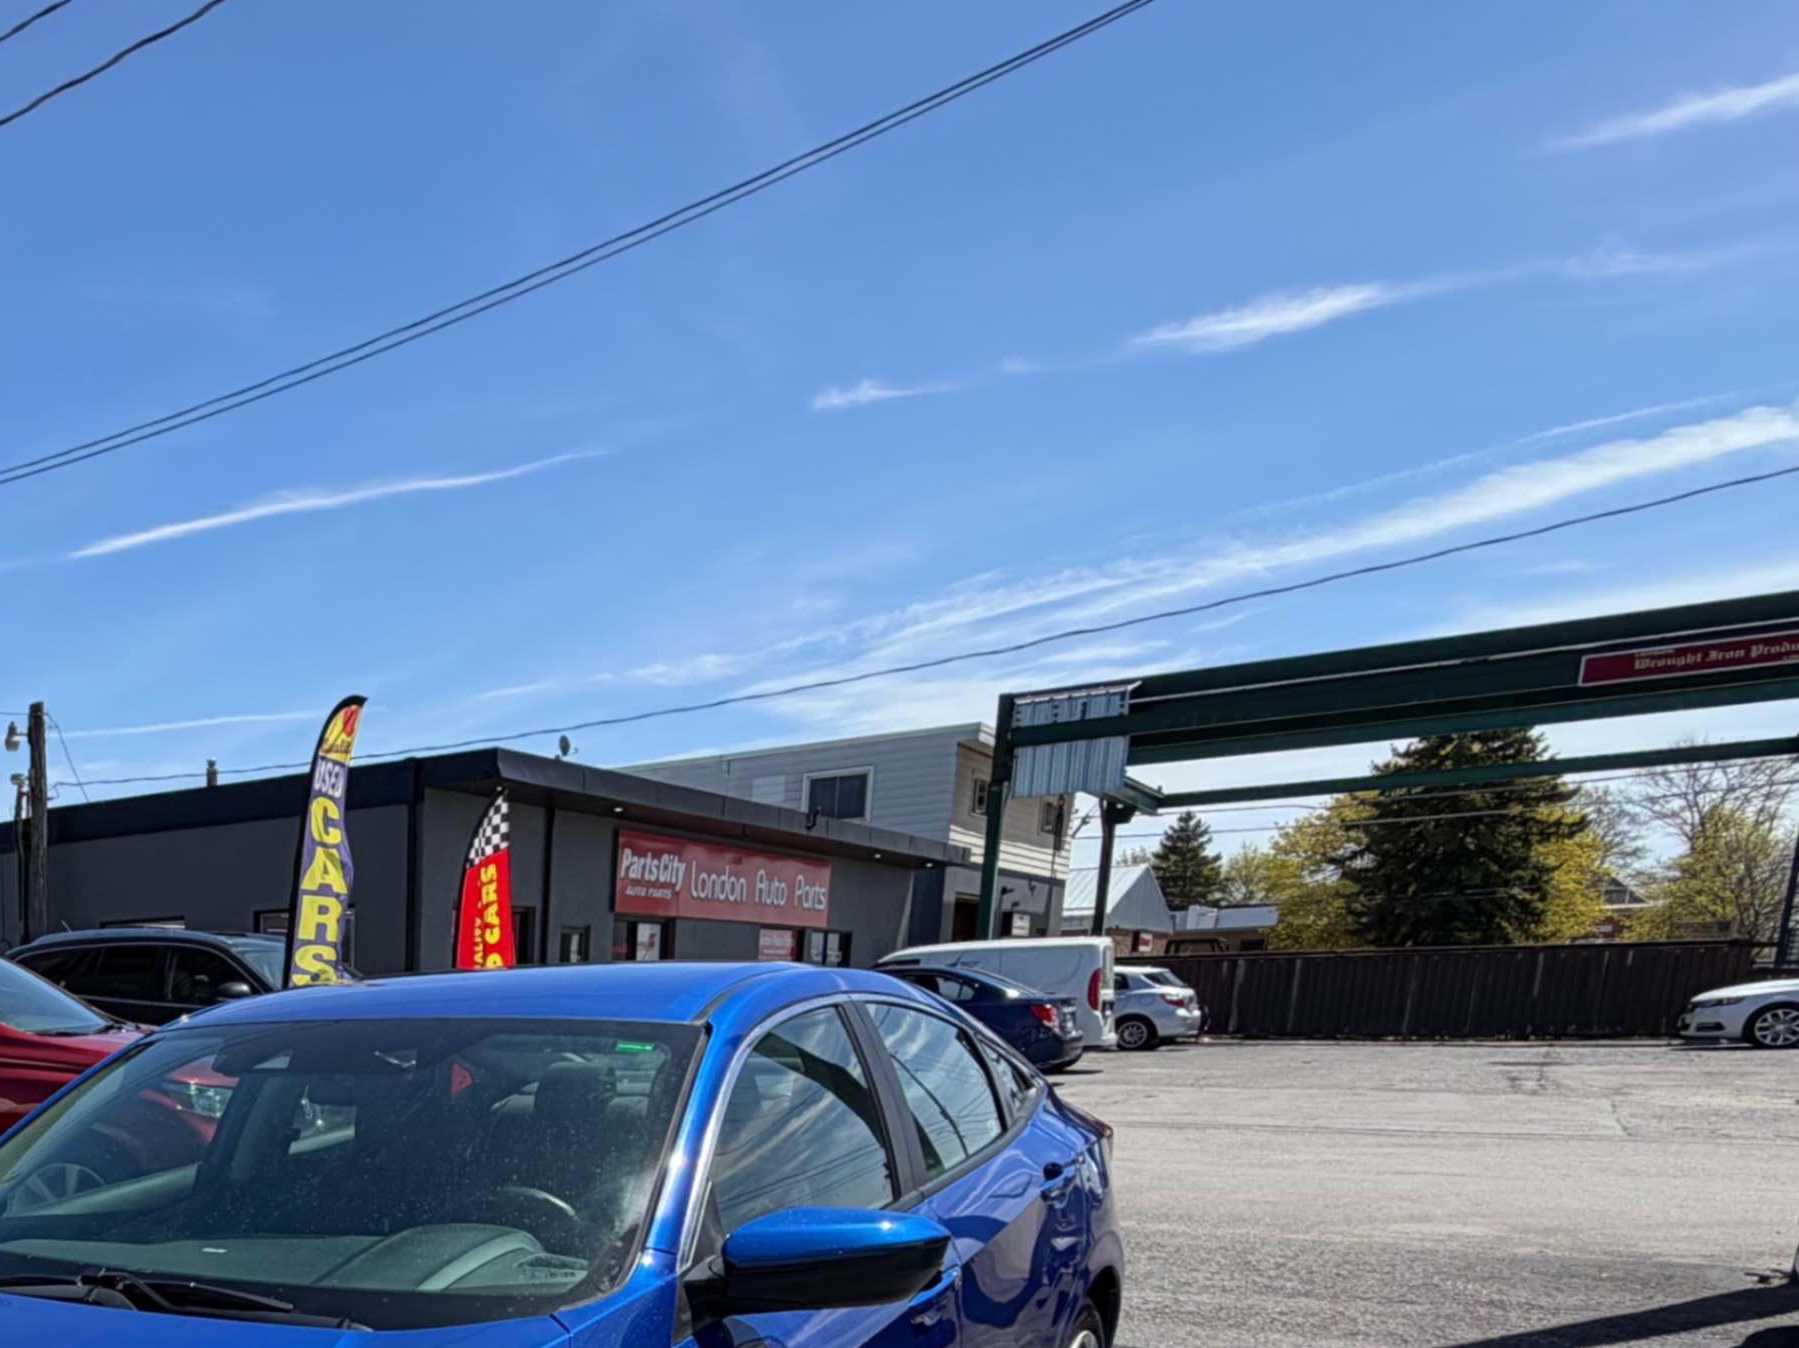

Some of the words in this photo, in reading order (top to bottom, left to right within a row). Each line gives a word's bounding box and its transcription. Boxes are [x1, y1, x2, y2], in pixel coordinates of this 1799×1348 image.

[1634, 653, 1702, 670] Wrought
[314, 761, 343, 798] USED
[292, 796, 349, 986] CARS
[621, 848, 686, 892] PartsCity
[690, 860, 747, 902] London
[754, 868, 788, 906] Auto
[794, 874, 827, 910] Parts
[480, 863, 502, 945] CARS
